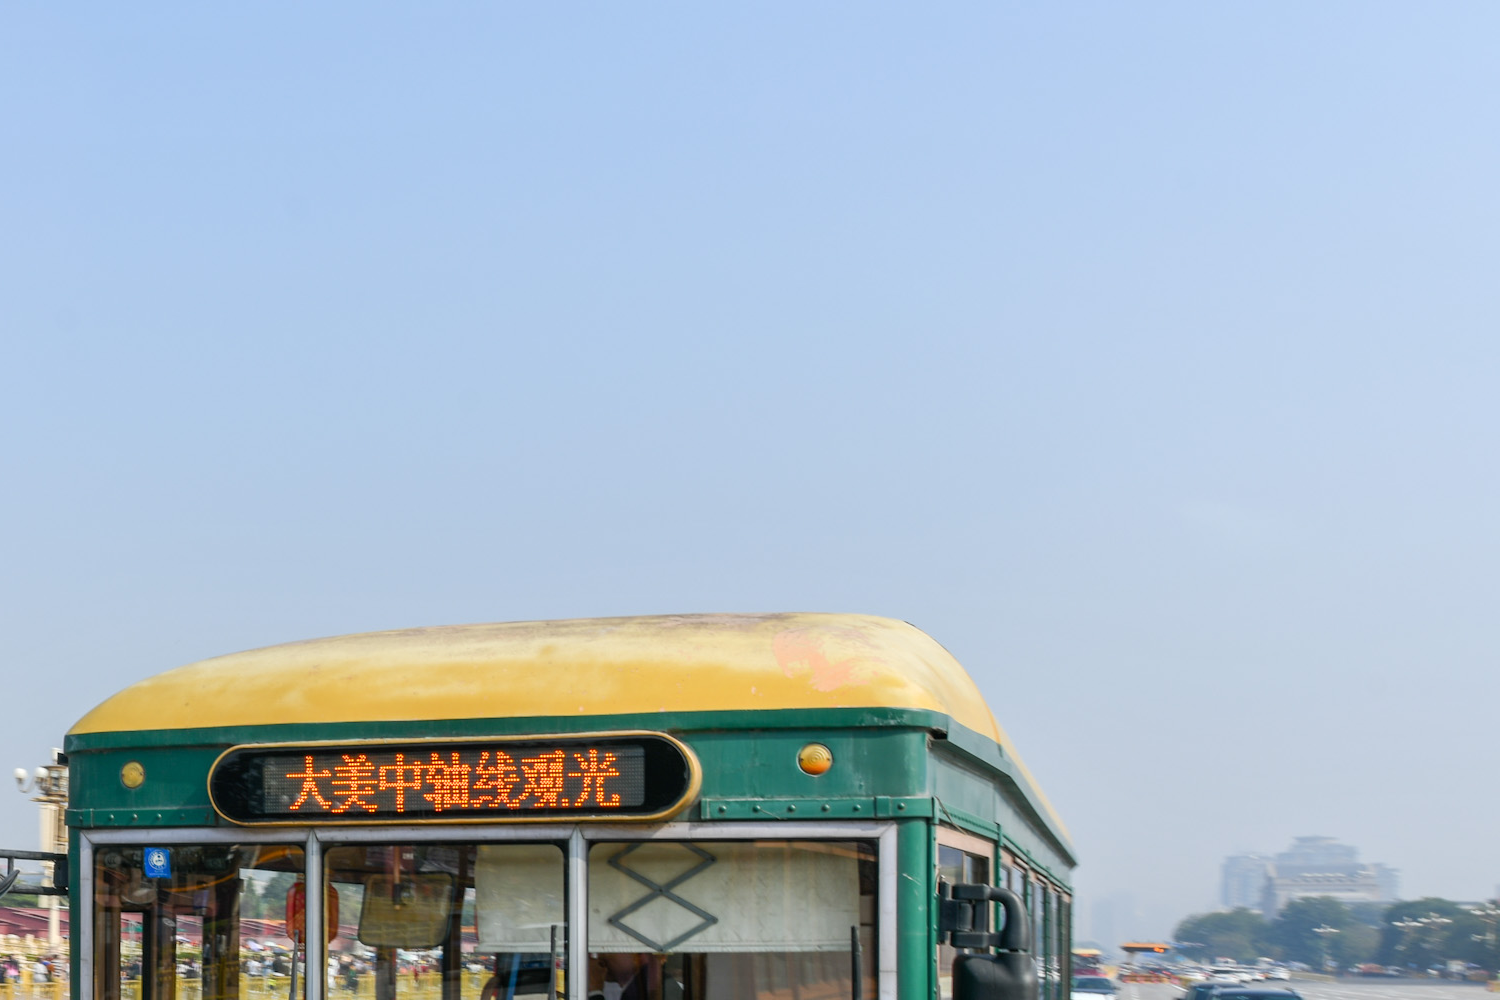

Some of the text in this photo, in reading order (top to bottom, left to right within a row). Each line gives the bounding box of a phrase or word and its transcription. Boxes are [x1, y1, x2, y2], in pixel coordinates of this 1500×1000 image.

[285, 749, 621, 813] 大美中轴线观光
